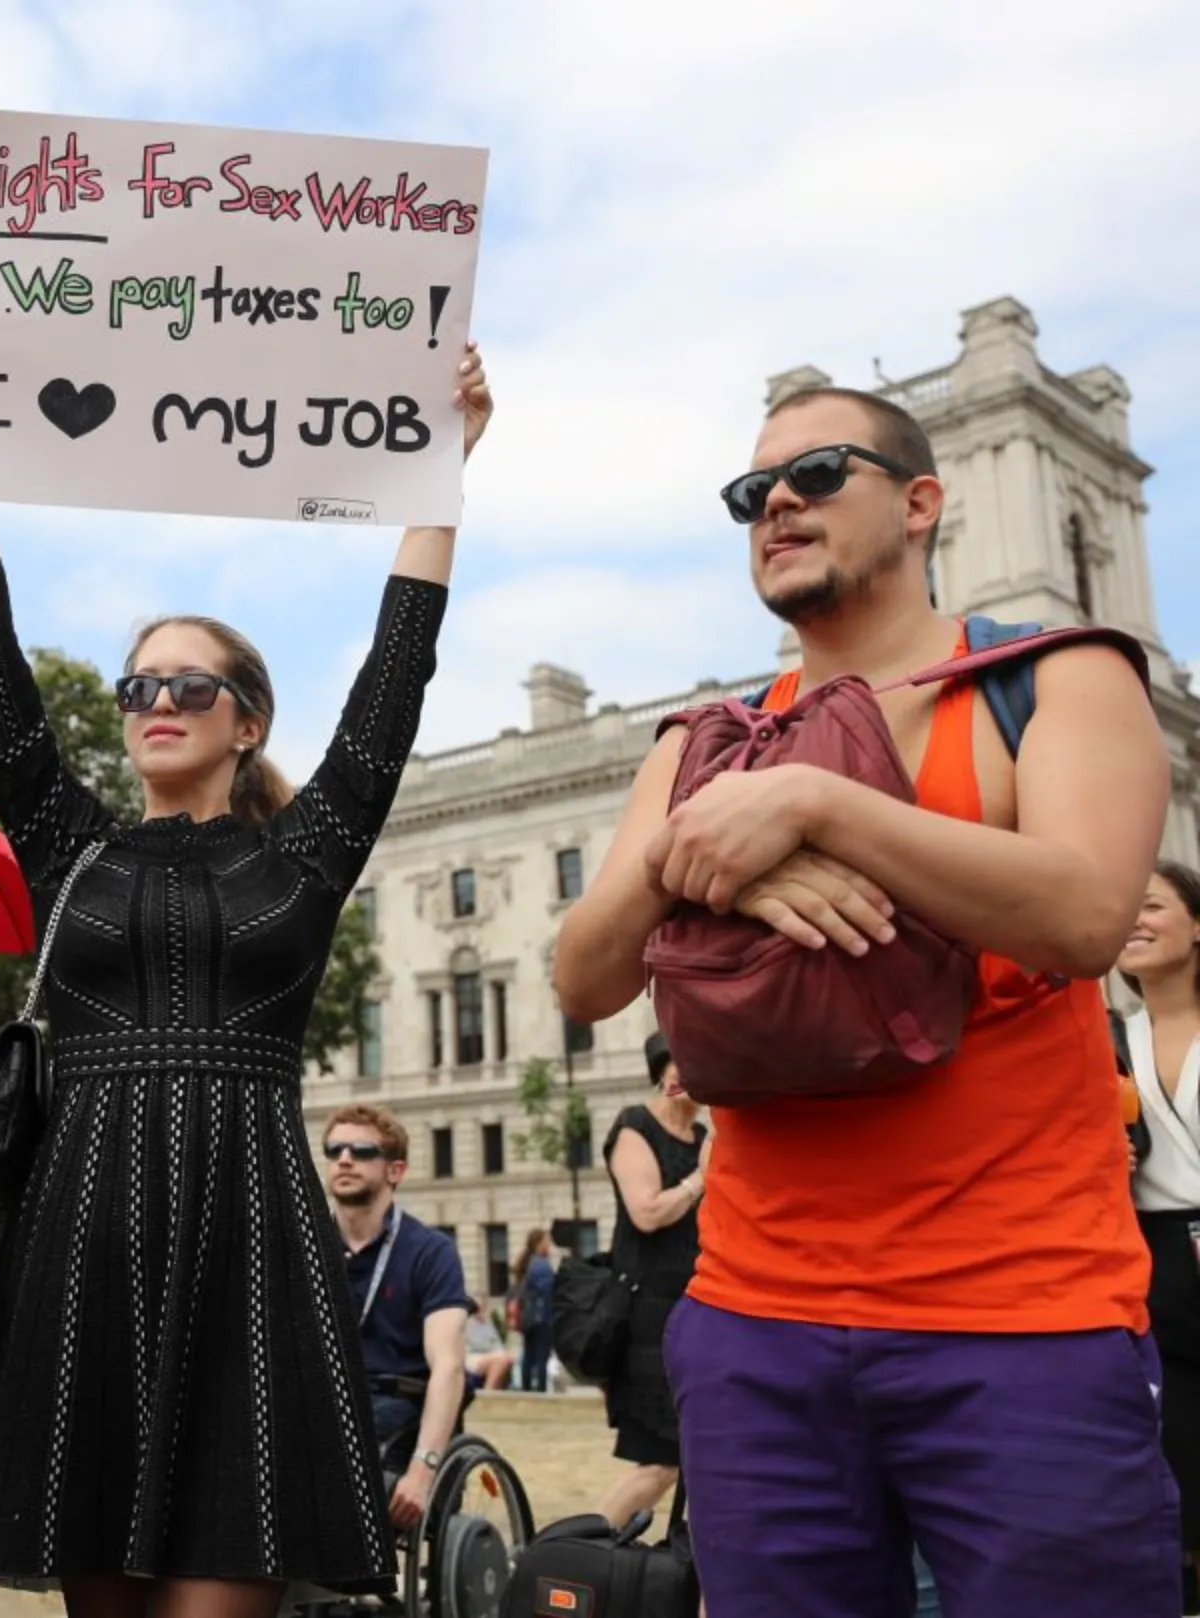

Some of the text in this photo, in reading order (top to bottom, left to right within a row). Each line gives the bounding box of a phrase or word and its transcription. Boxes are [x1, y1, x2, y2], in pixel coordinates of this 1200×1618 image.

[219, 154, 302, 221] Sex
[109, 275, 196, 340] pay
[201, 266, 321, 325] taxes
[298, 395, 432, 453] JOB
